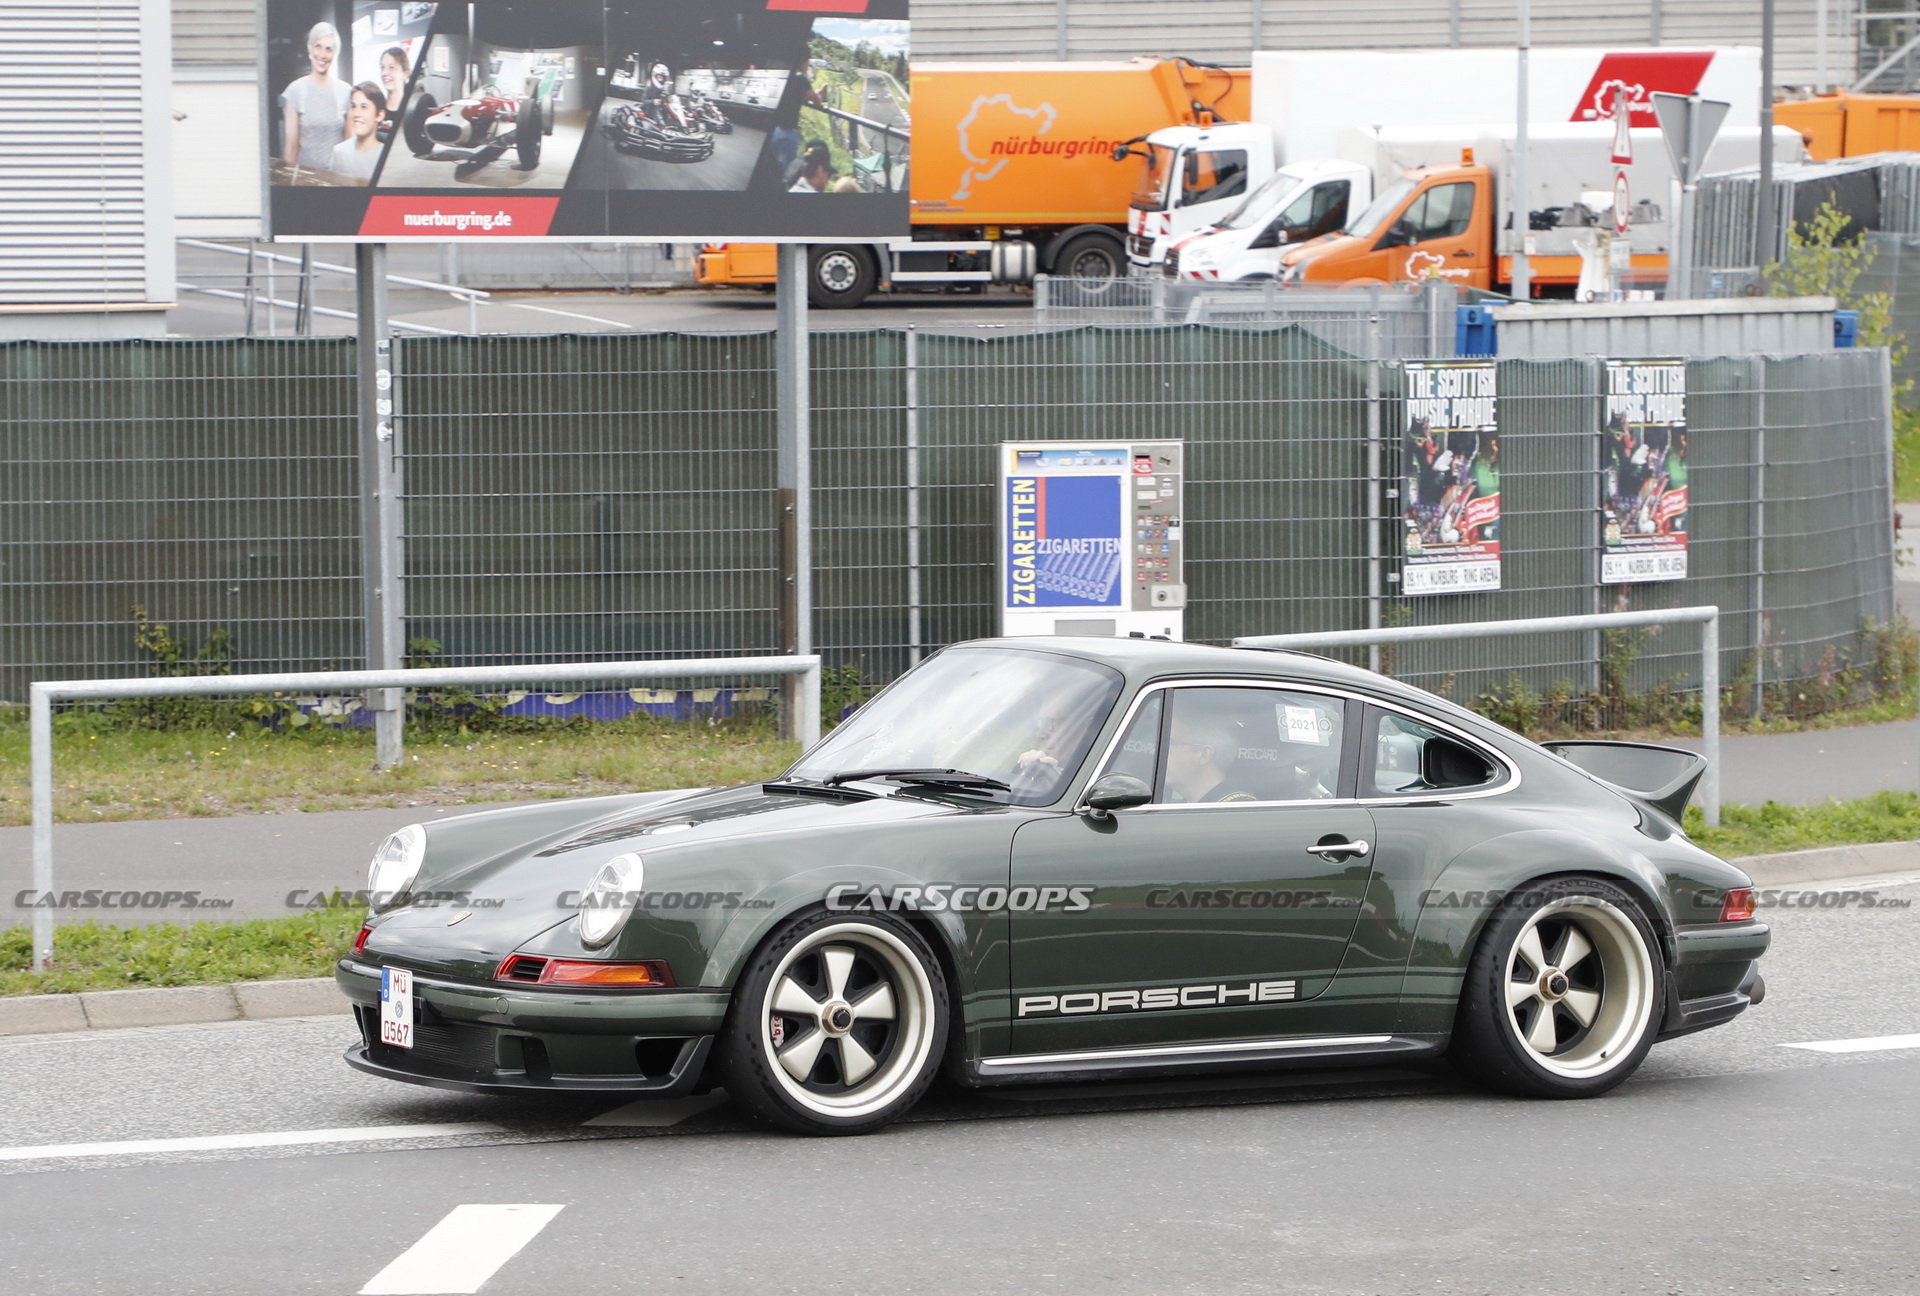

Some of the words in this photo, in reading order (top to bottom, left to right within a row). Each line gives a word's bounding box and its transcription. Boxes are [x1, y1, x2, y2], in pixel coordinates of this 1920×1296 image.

[404, 210, 512, 230] nuerburgring.de
[1405, 369, 1436, 398] THE
[1437, 368, 1496, 398] SCOTTISH
[1607, 366, 1632, 394] THE
[1633, 366, 1686, 394] SCOTTISH
[1012, 479, 1036, 605] ZIGARETTEN
[1037, 538, 1120, 554] ZIGARETTEN
[1464, 568, 1477, 584] RING
[1290, 718, 1315, 731] 2021
[1238, 748, 1278, 761] RECARO
[394, 973, 406, 993] MÜ
[1018, 980, 1296, 1017] PORSCHE
[384, 1020, 409, 1044] 0567
